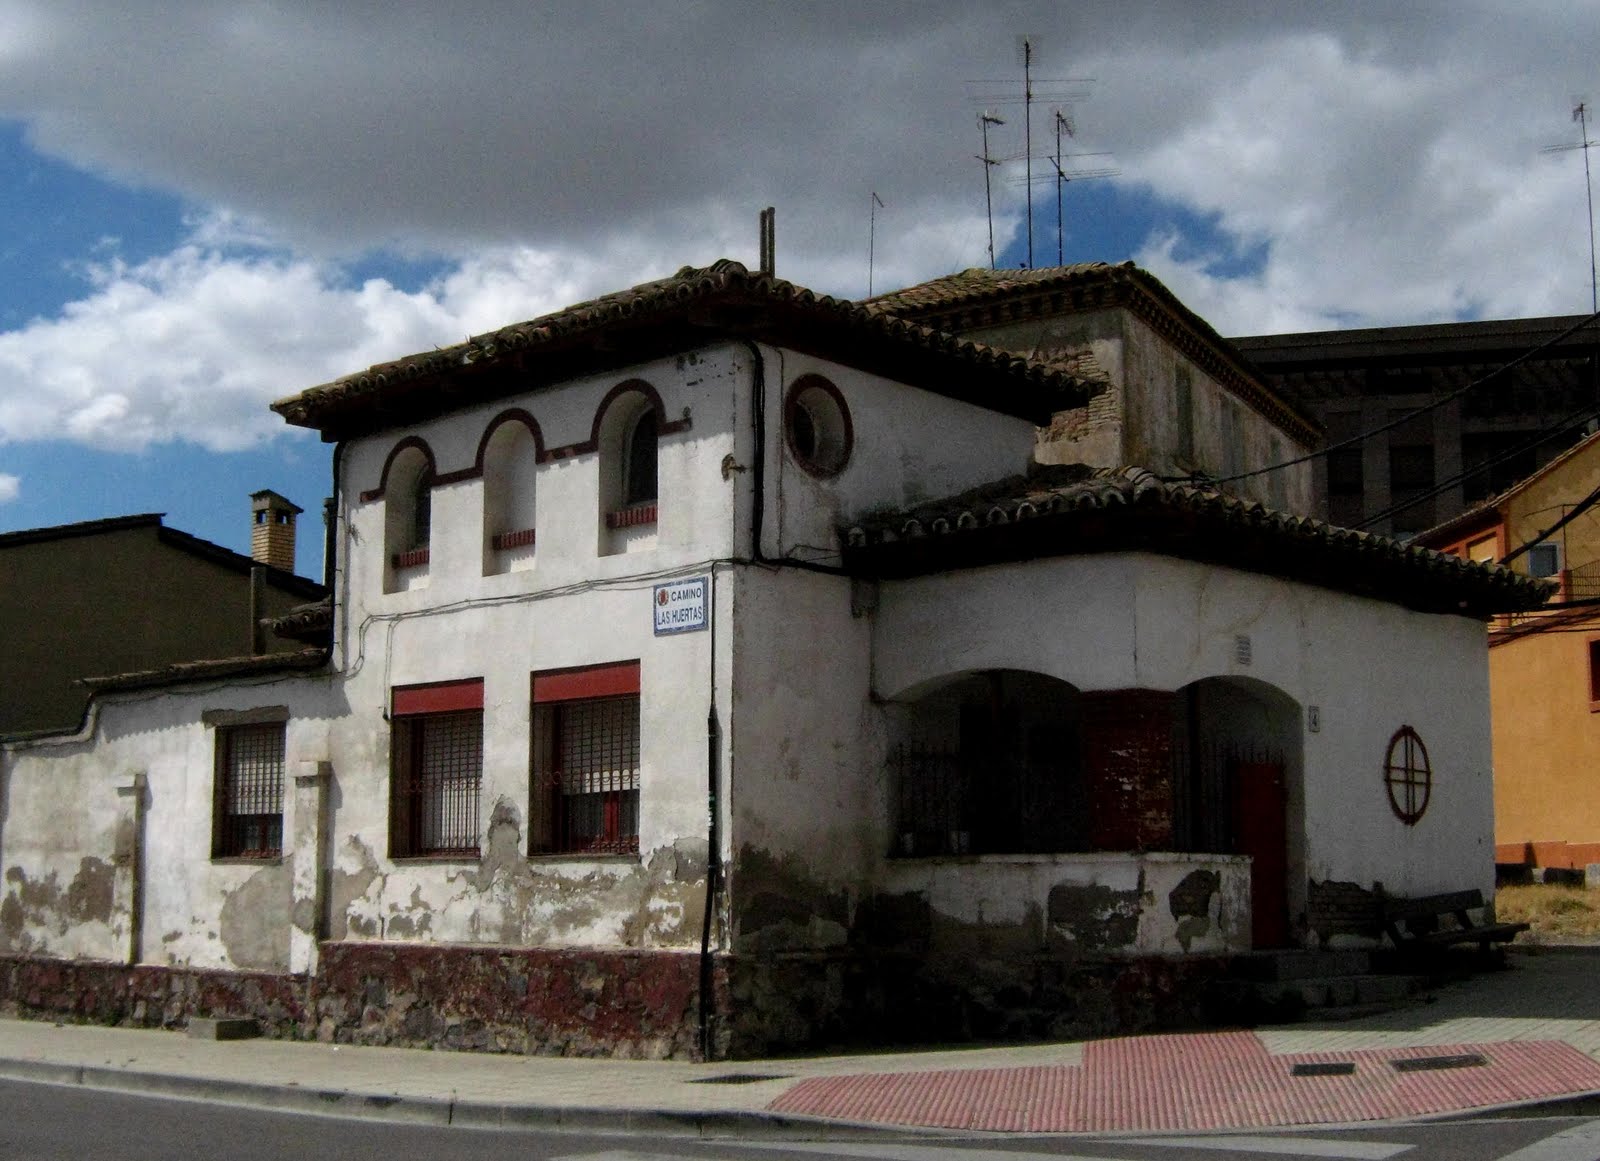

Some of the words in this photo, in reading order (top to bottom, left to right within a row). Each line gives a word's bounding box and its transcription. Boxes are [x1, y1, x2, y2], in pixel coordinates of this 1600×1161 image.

[671, 588, 702, 601] CAMINO
[657, 611, 670, 625] LAS
[671, 606, 702, 623] HUERTAS
